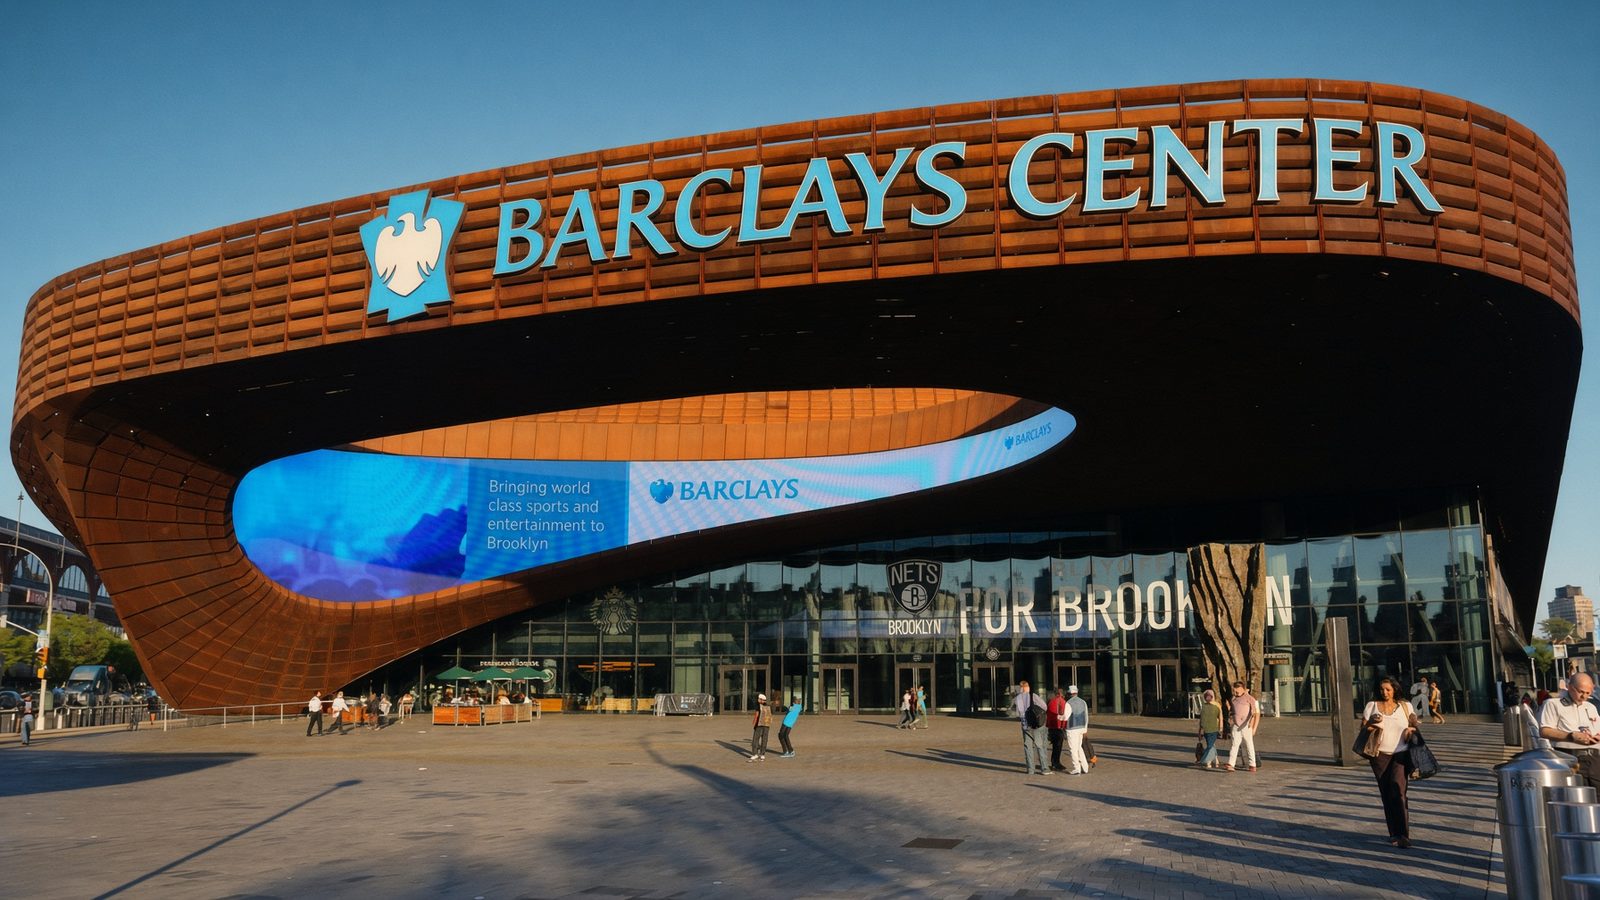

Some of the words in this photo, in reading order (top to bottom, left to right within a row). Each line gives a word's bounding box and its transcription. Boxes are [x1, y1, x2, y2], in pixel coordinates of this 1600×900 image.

[493, 141, 968, 276] BARCLAYS
[1008, 117, 1446, 217] CENTER
[1014, 422, 1052, 446] BARCLAYS
[489, 479, 547, 496] Bringing
[552, 480, 591, 495] world
[679, 478, 799, 501] BARCLAYS
[488, 497, 522, 513] class
[526, 500, 569, 515] sports
[573, 499, 599, 514] and
[487, 518, 586, 533] entertainment
[590, 519, 605, 533] to
[487, 535, 548, 553] Brooklyn
[891, 562, 938, 586] NETS
[1059, 575, 1293, 632] BROOKN
[888, 619, 941, 636] BROOKLYN
